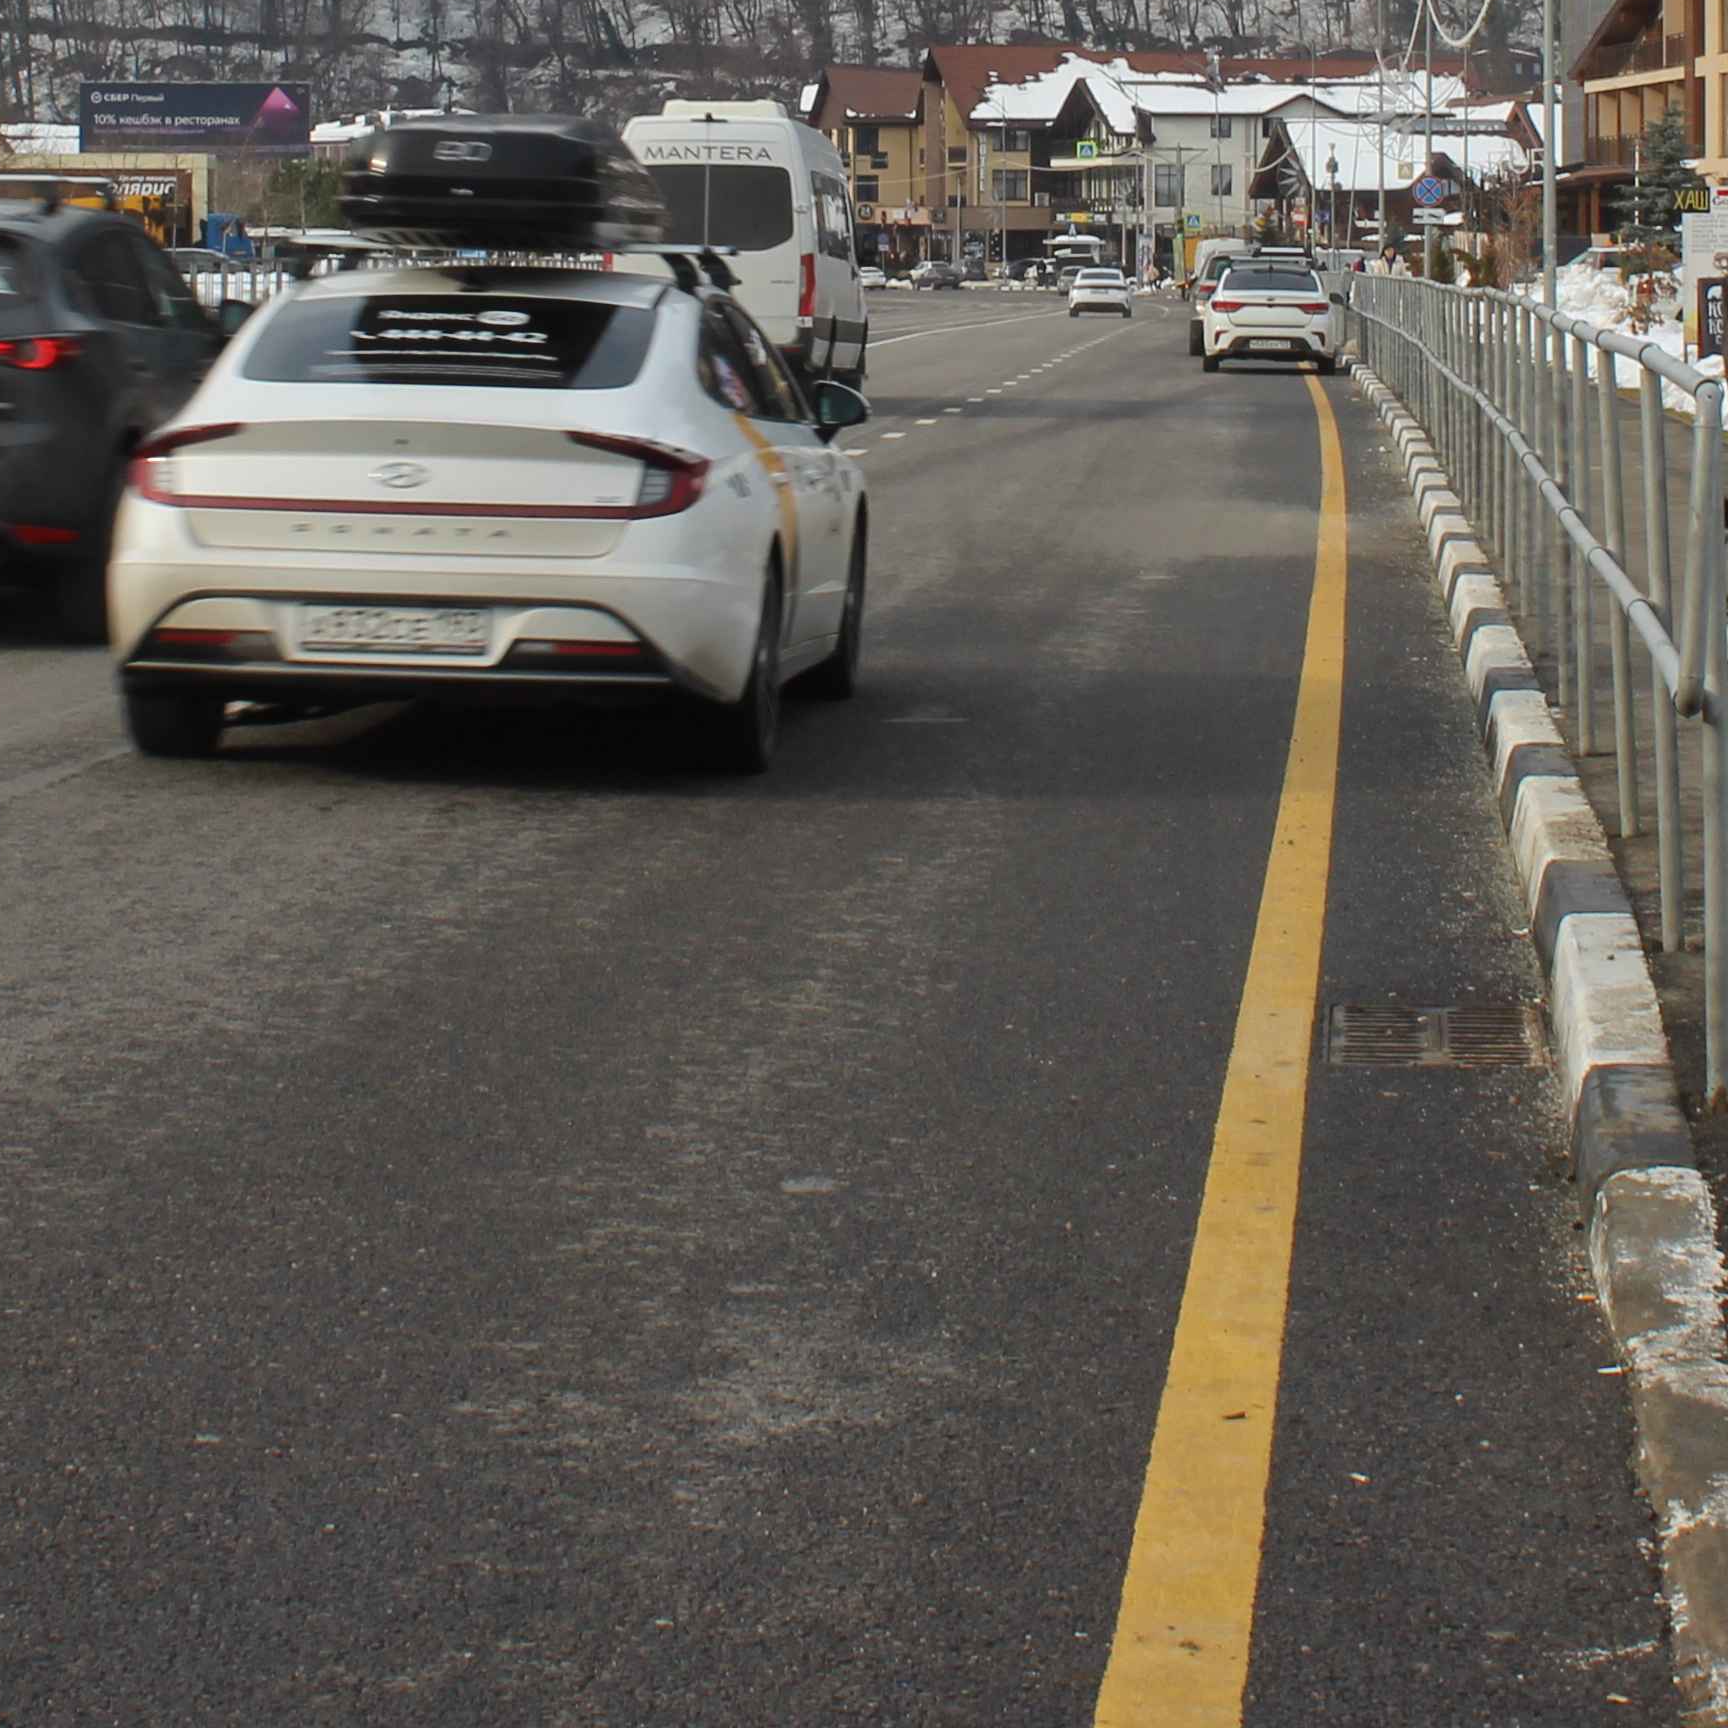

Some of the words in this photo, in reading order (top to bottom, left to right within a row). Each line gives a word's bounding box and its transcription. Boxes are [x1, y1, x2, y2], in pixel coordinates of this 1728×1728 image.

[103, 93, 130, 103] СБЕР
[130, 92, 165, 104] Первый
[93, 113, 116, 125] 10%
[119, 112, 162, 126] кешбэк
[164, 116, 172, 125] в
[174, 116, 241, 127] ресторанах
[643, 144, 774, 162] MANTERA
[1673, 188, 1709, 210] ХАШ
